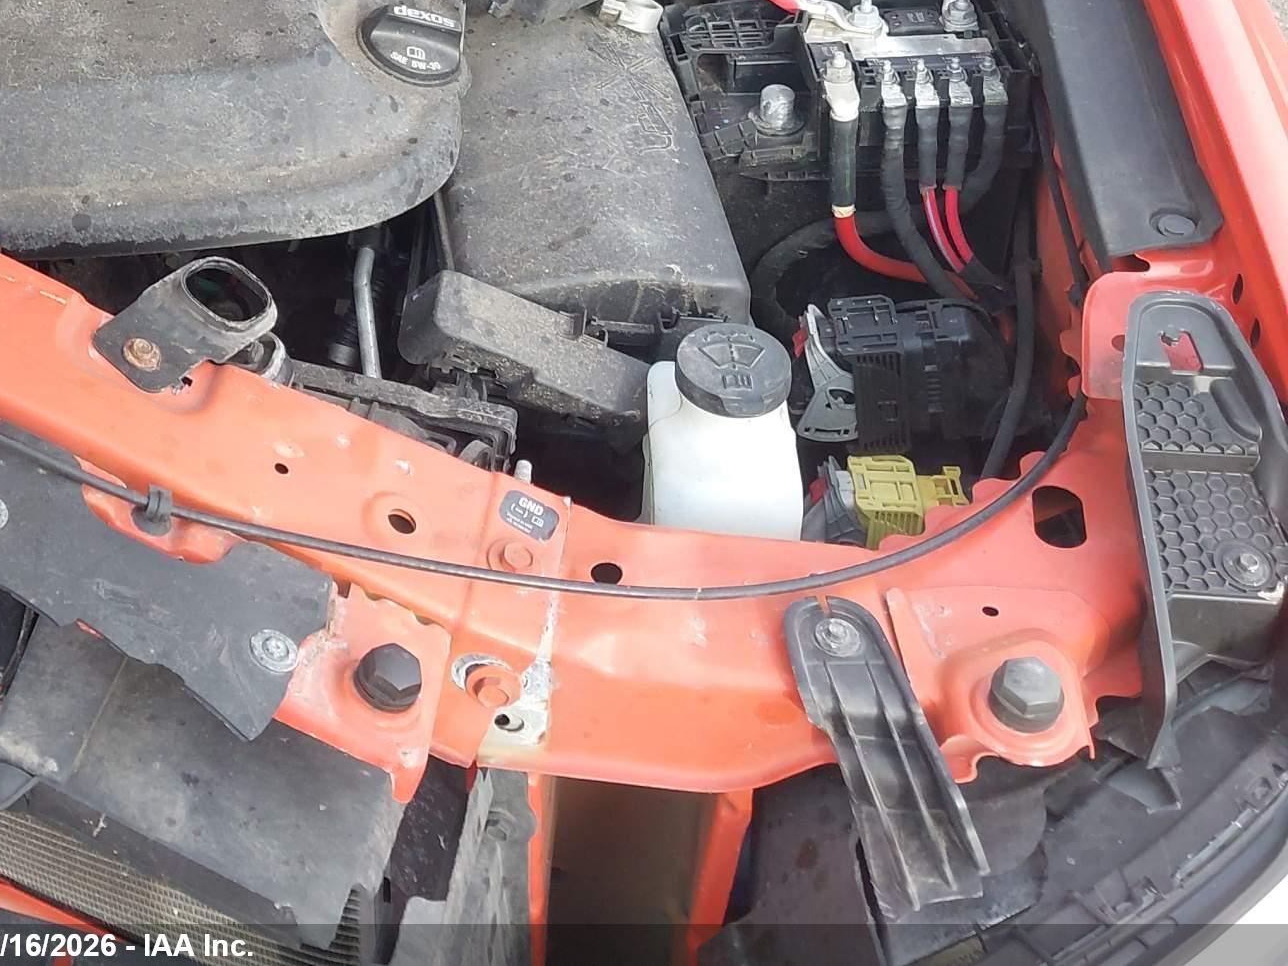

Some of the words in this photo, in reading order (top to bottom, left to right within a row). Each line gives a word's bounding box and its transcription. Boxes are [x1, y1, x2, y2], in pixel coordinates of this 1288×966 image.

[394, 5, 455, 27] dexos
[390, 51, 408, 64] SAE
[518, 497, 544, 516] GND
